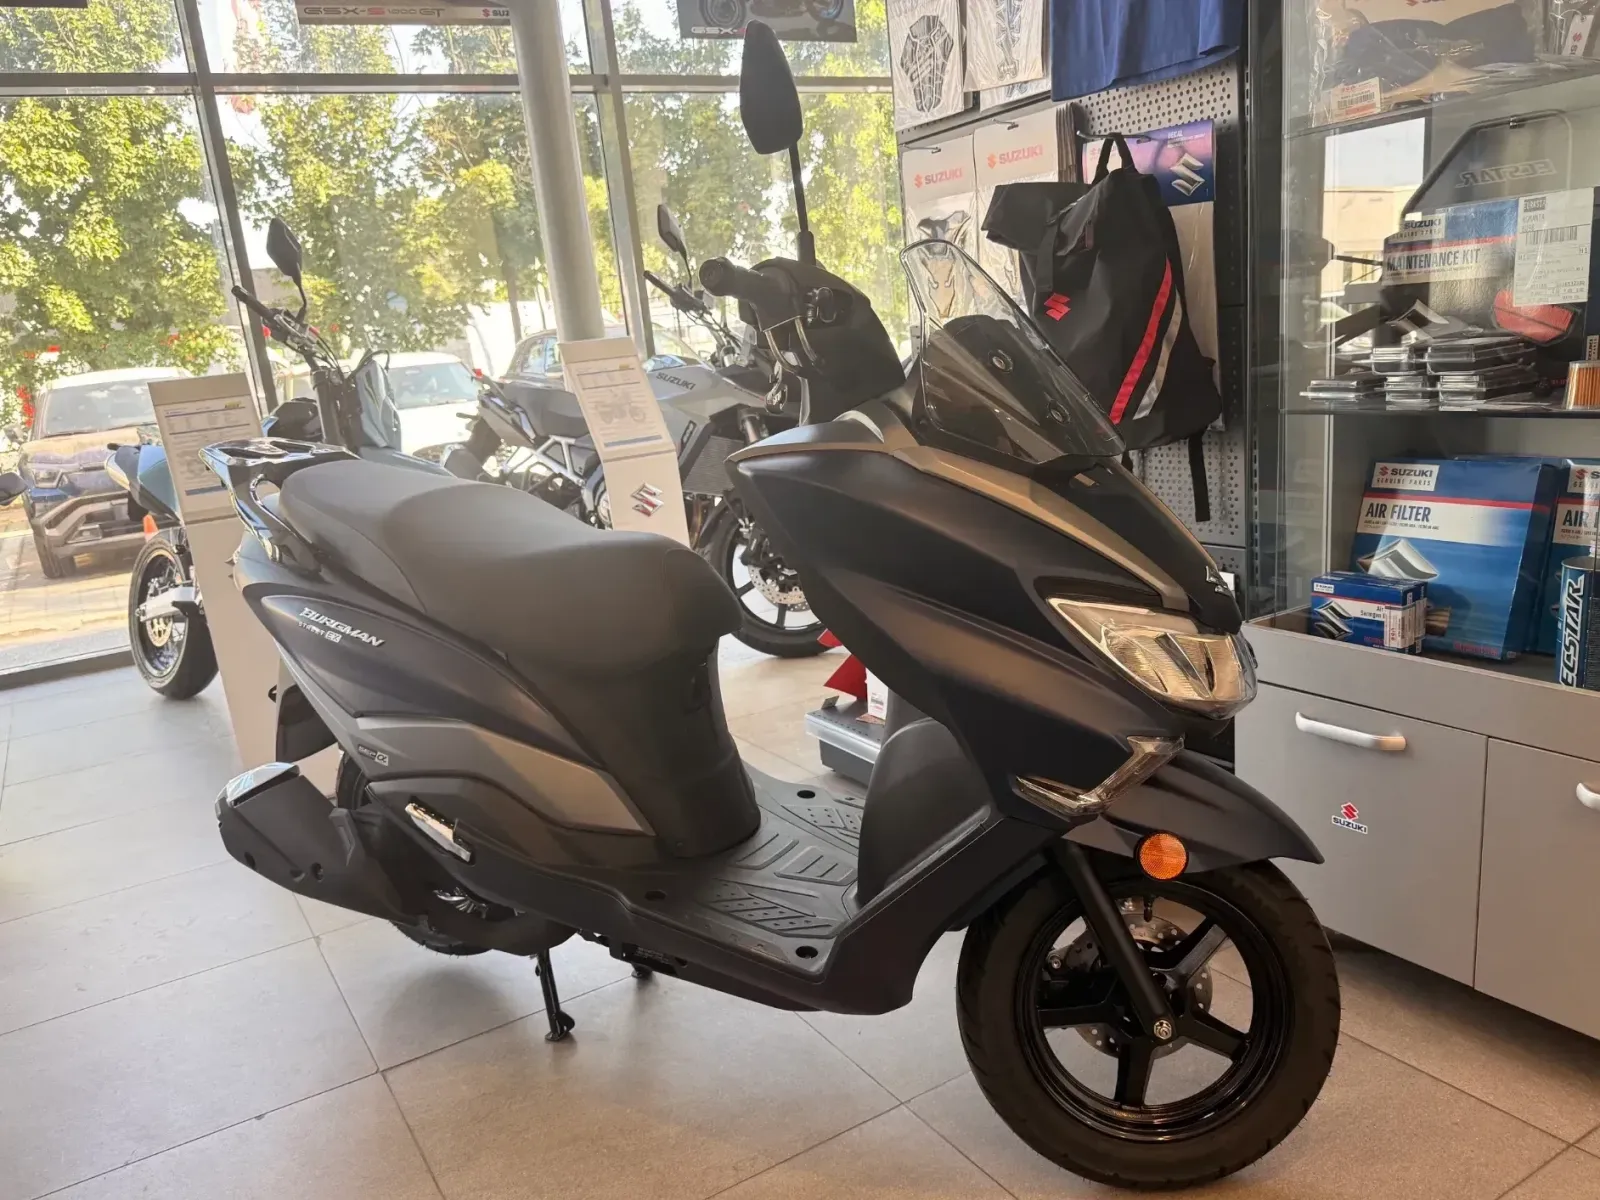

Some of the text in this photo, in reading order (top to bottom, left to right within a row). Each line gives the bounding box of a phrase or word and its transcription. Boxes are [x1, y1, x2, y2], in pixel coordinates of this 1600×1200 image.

[999, 144, 1044, 165] SUZUKI
[924, 168, 963, 185] SUZUKI
[1404, 219, 1441, 229] SUZUKI
[1387, 251, 1459, 271] MAINTENANCE
[1462, 248, 1480, 264] KIT
[656, 371, 696, 390] SUZUKI
[1391, 468, 1433, 477] SUZUKI
[1365, 502, 1431, 522] AIR FILTER
[1563, 509, 1589, 527] AIR
[300, 607, 385, 647] BURGMAN
[1561, 574, 1585, 687] ECSTAR
[1332, 816, 1367, 833] SUZUKI
